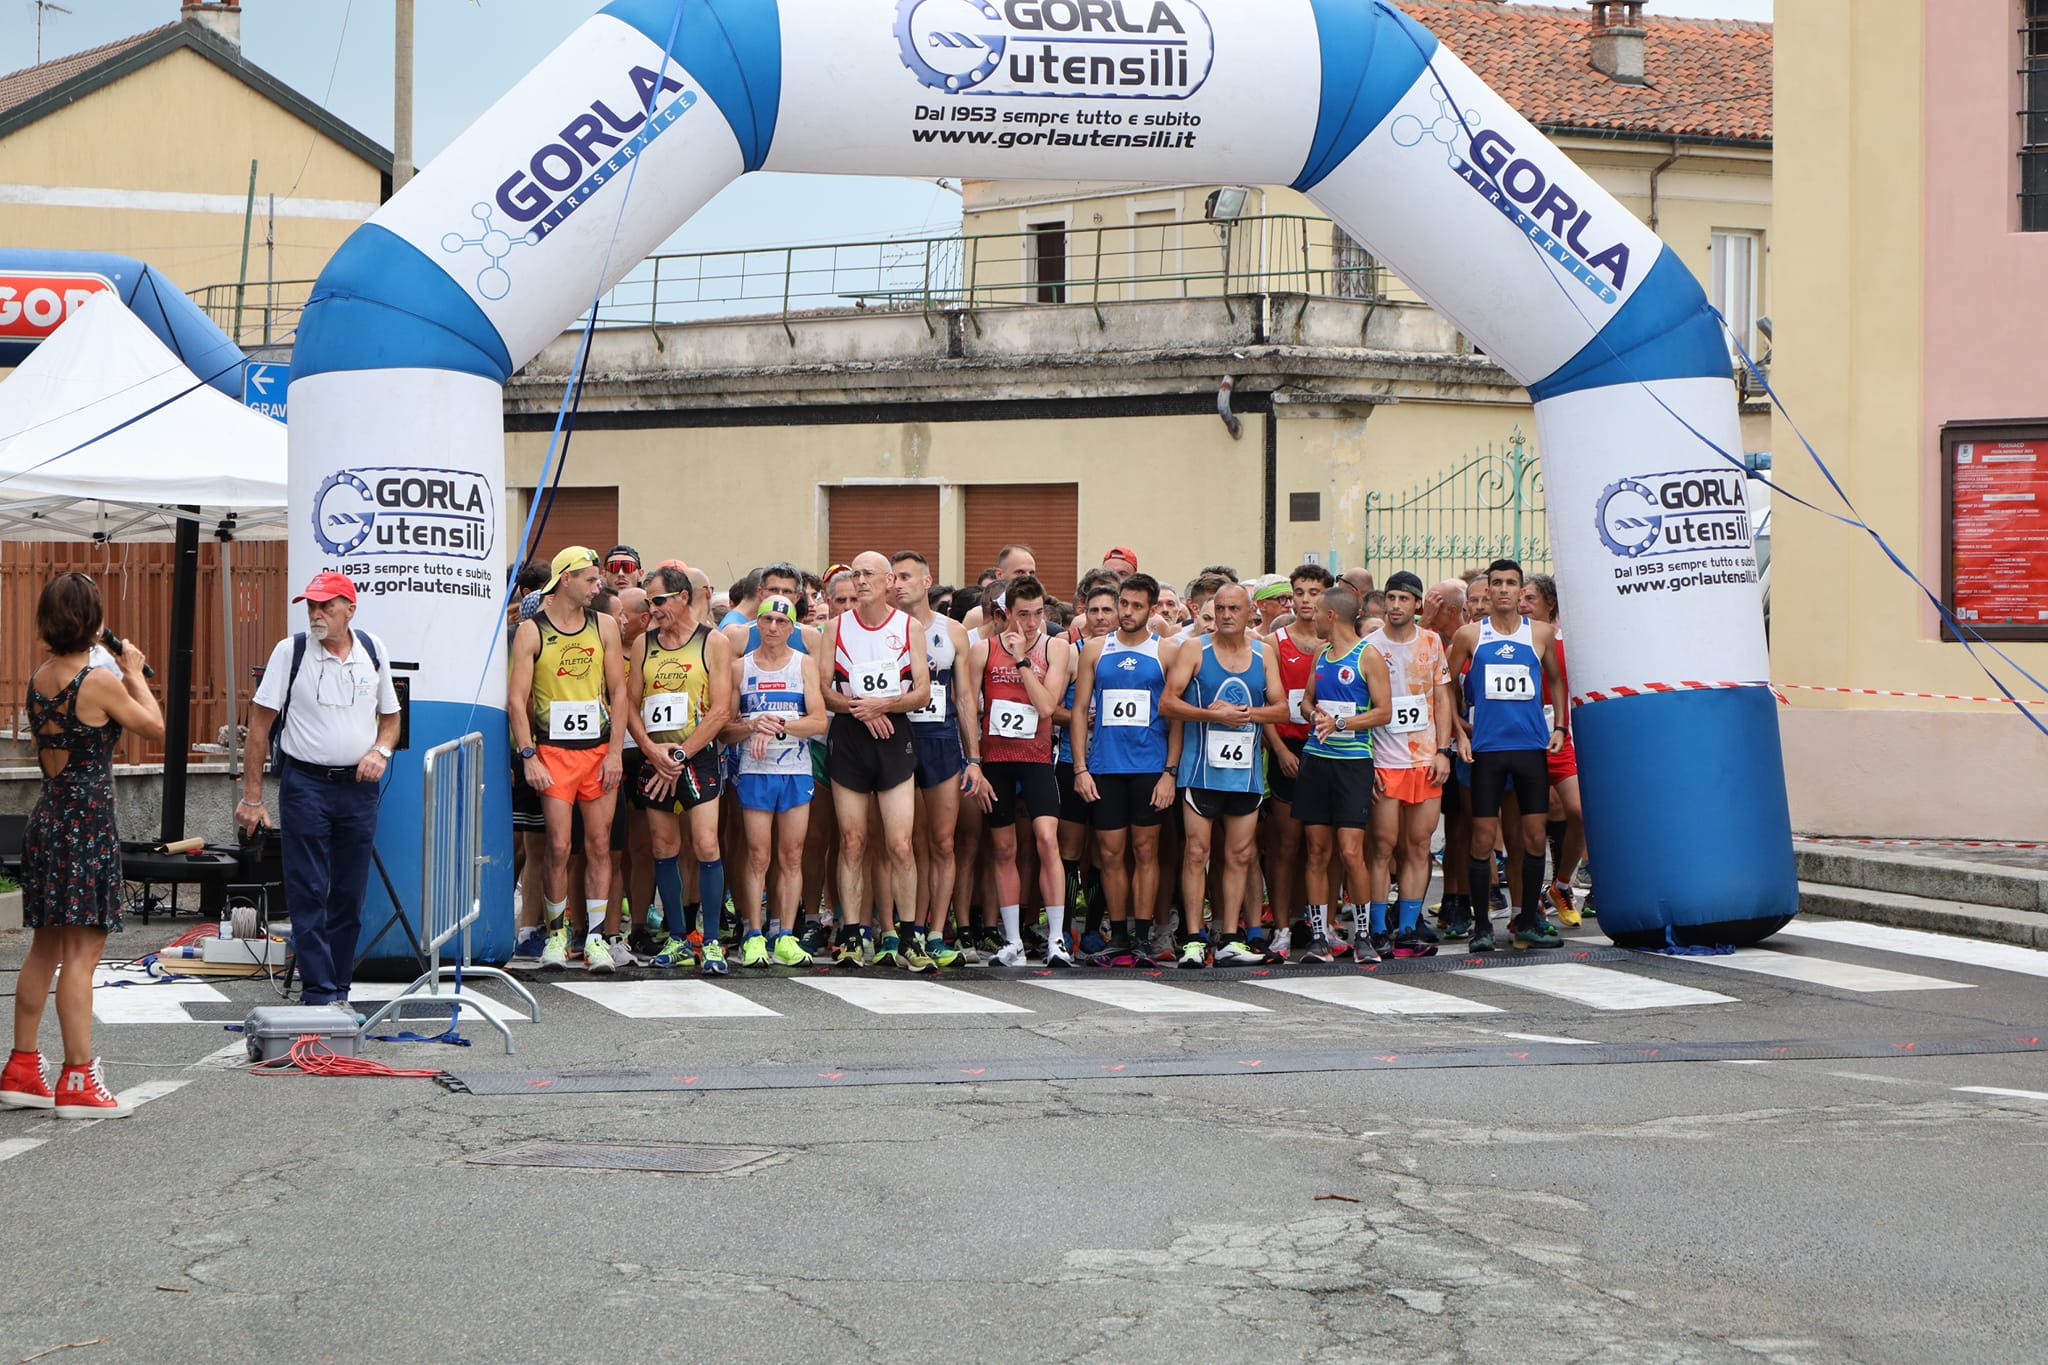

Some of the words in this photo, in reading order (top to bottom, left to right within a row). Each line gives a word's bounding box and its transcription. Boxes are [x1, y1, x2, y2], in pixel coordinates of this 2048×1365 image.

[1004, 0, 1186, 34] GORLA
[1010, 45, 1187, 86] utensili
[915, 105, 945, 122] Dal
[951, 107, 997, 123] 1953
[1002, 111, 1069, 127] sempre
[1076, 109, 1122, 126] tutto
[1128, 115, 1138, 126] e
[1144, 110, 1201, 127] subito
[496, 65, 684, 222] GORLA
[912, 128, 1197, 148] www.gorlautensili.it
[1469, 128, 1630, 291] GORLA
[376, 478, 485, 514] GORLA
[1660, 479, 1744, 509] GORLA
[377, 518, 485, 551] utensili
[1665, 515, 1749, 544] utensili
[342, 563, 370, 575] 1953
[374, 564, 420, 576] sempre
[424, 564, 453, 576] tutto
[466, 569, 491, 581] subito
[1614, 566, 1632, 579] Dal
[1636, 562, 1664, 576] 1953
[1667, 558, 1708, 572] sempre
[1710, 556, 1733, 567] tutto
[560, 657, 593, 666] ATLETICA
[655, 672, 688, 680] ATLETICA
[863, 672, 888, 691] 86
[1494, 677, 1526, 693] 101
[652, 705, 672, 723] 61
[913, 697, 937, 714] 4
[1113, 702, 1137, 718] 60
[563, 714, 588, 731] 65
[1001, 712, 1024, 730] 92
[1397, 708, 1419, 725] 59
[1220, 744, 1243, 761] 46
[67, 1071, 85, 1091] R
